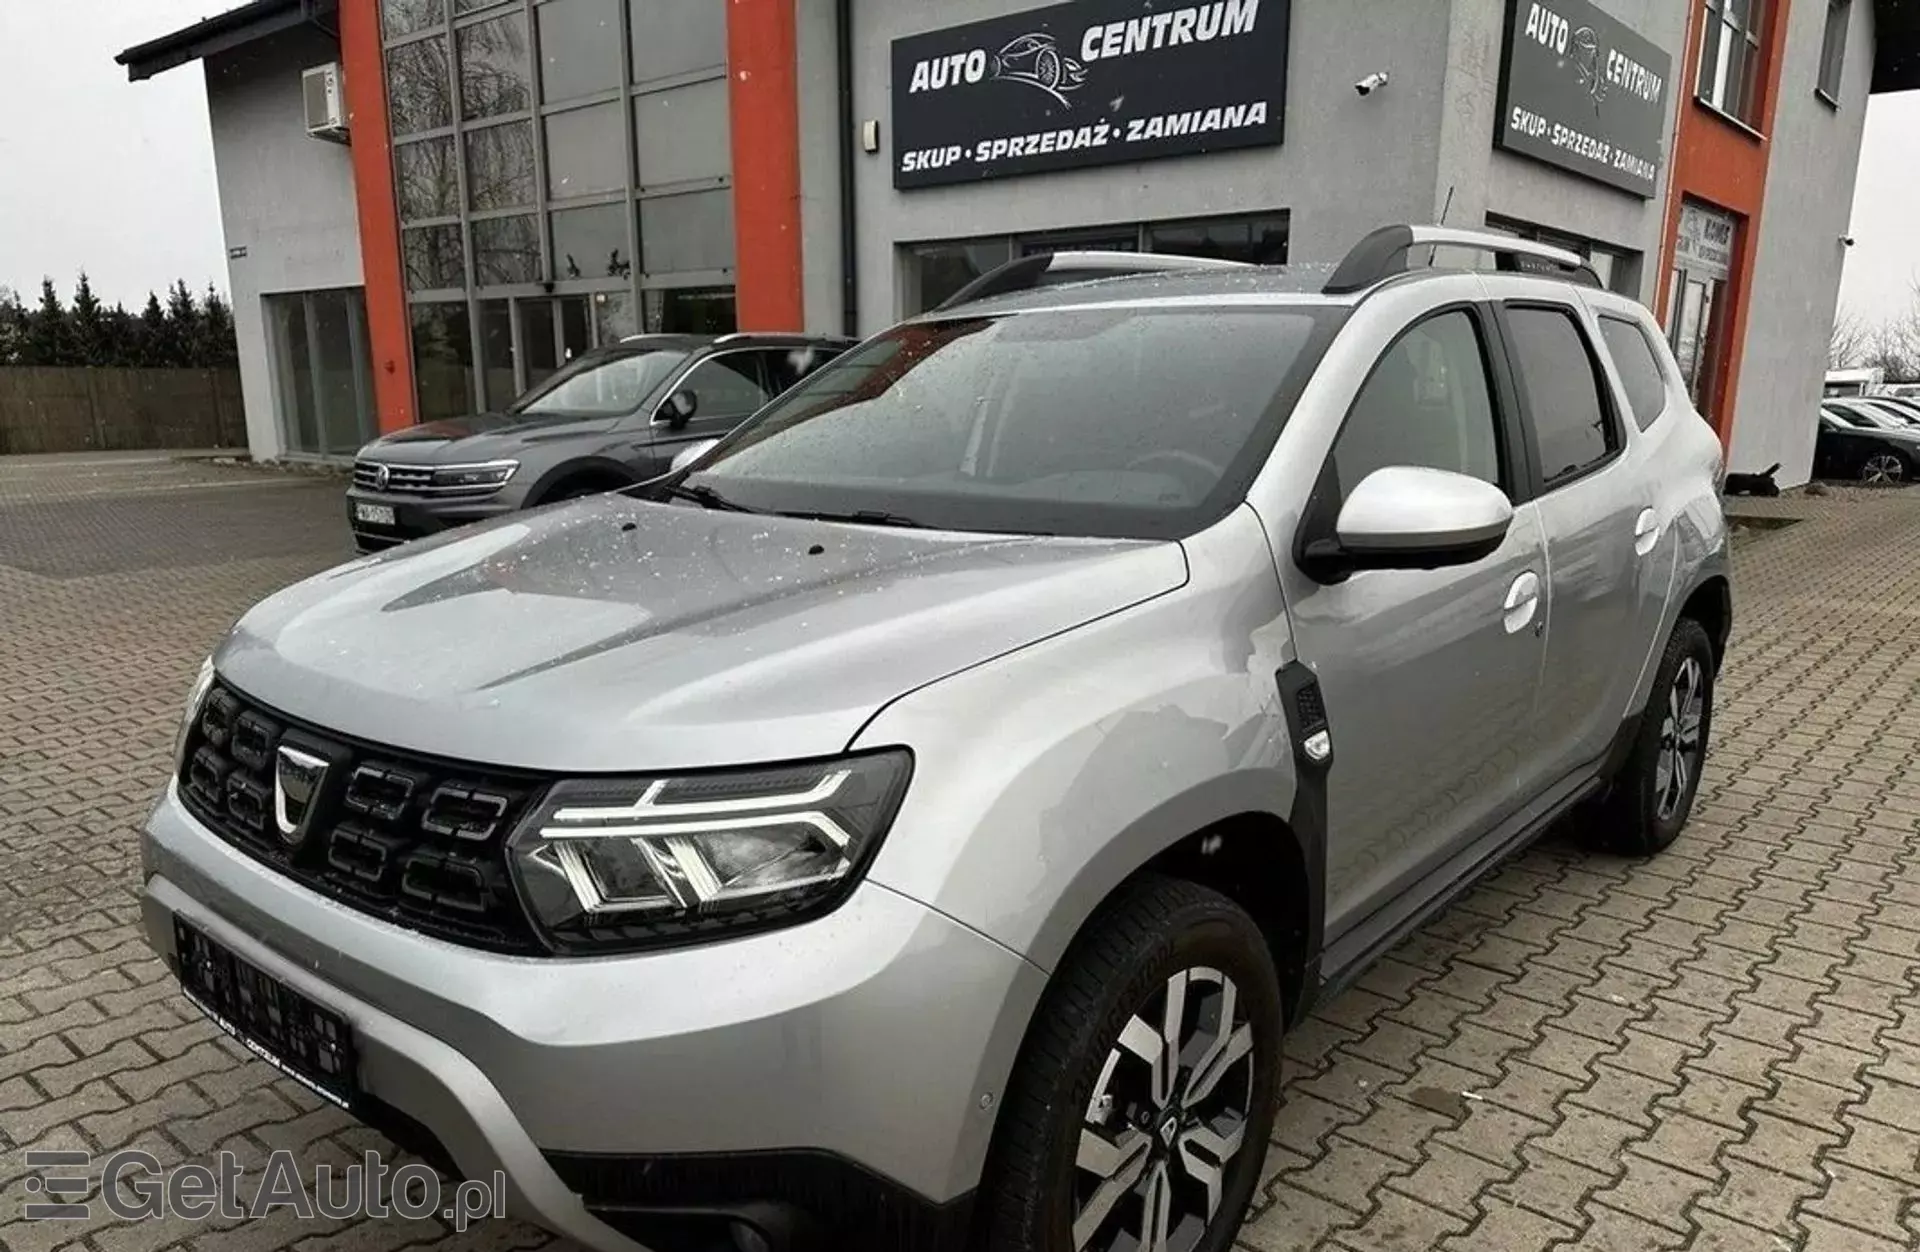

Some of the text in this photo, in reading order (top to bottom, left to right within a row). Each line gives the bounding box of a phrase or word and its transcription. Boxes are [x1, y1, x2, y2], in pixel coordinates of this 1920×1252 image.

[909, 0, 1260, 93] AUTO CENTRUM
[1525, 3, 1662, 103] AUTO CENTRUM
[901, 101, 1267, 172] SKUP SPRZEDAŻ ZAMIANA
[1511, 106, 1546, 138] SKUP
[1613, 149, 1656, 180] ZAMIANA
